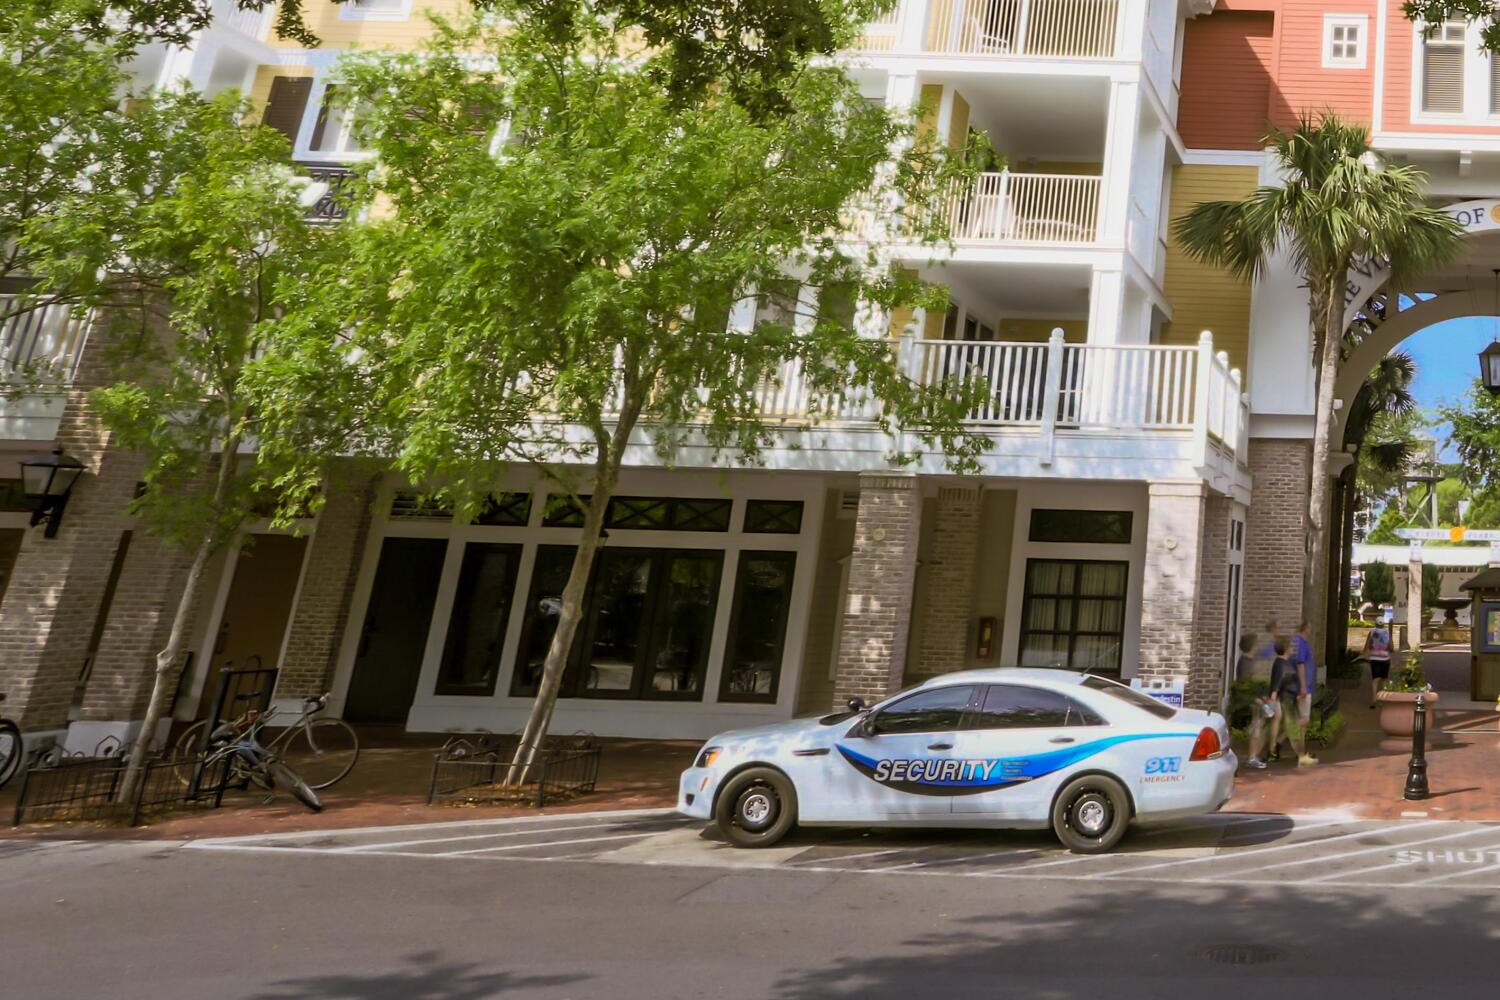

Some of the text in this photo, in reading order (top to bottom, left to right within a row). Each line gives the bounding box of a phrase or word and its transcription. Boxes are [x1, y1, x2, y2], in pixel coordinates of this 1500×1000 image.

[1456, 207, 1486, 227] OF
[873, 759, 998, 781] SECURITY
[1144, 756, 1182, 774] 911
[1139, 775, 1185, 784] EMERGENCY
